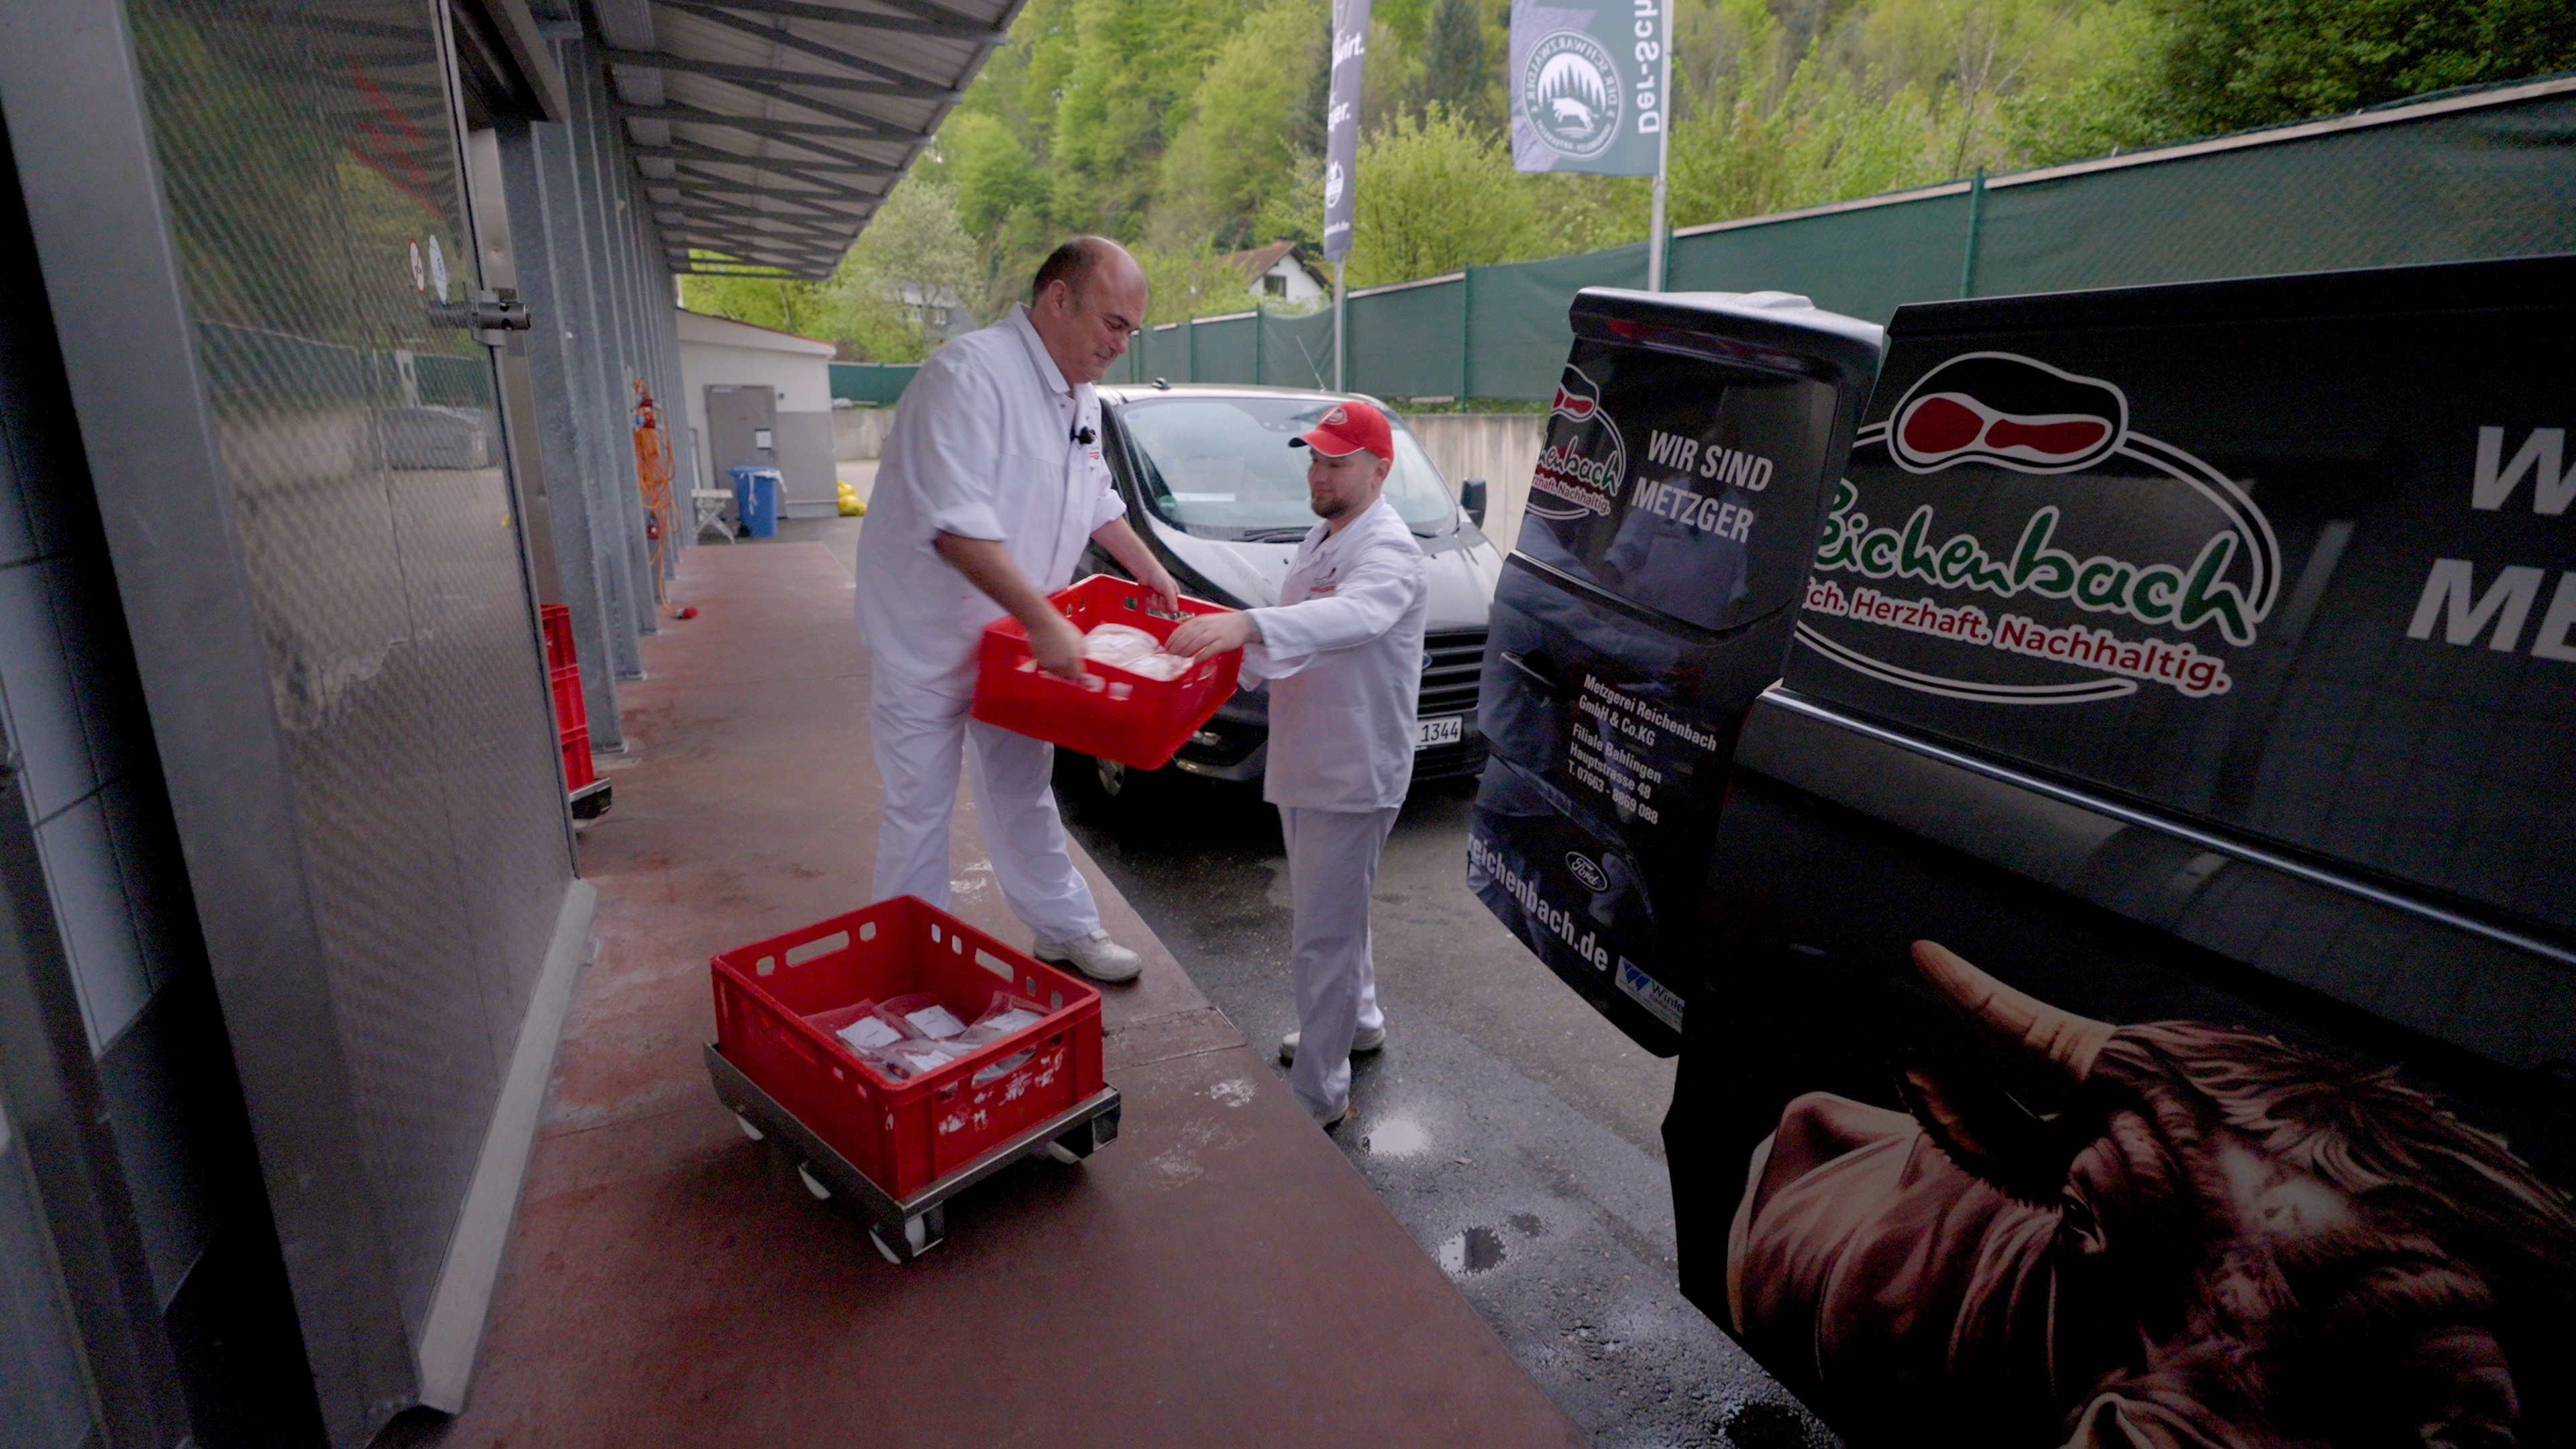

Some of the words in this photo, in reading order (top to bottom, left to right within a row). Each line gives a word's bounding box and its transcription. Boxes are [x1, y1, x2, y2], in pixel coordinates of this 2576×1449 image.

[1648, 429, 1699, 472] WIR
[1700, 445, 1773, 492] SIND
[1558, 483, 1610, 515] Nachhaltig.
[1631, 476, 1754, 543] METZGER
[1851, 590, 1991, 642] Herzhaft.
[2002, 619, 2229, 693] Nachhaltig.
[1421, 720, 1458, 743] 1344
[1578, 694, 1609, 722] GmbH
[1609, 711, 1619, 729] &
[1621, 717, 1656, 747] Co.KG
[1583, 674, 1636, 712] Metzgerei
[1636, 701, 1717, 752] Reichenbach
[1570, 741, 1635, 791] Hauptstrasse
[1637, 782, 1652, 800] 48
[1572, 722, 1603, 752] Filiale
[1605, 741, 1662, 784] Bahlingen
[1568, 759, 1575, 776] T.
[1576, 765, 1604, 793] 07663
[1612, 788, 1637, 812] 8869
[1638, 803, 1659, 825] 088
[1468, 832, 1609, 972] reichenbach.de
[1571, 857, 1600, 885] Ford
